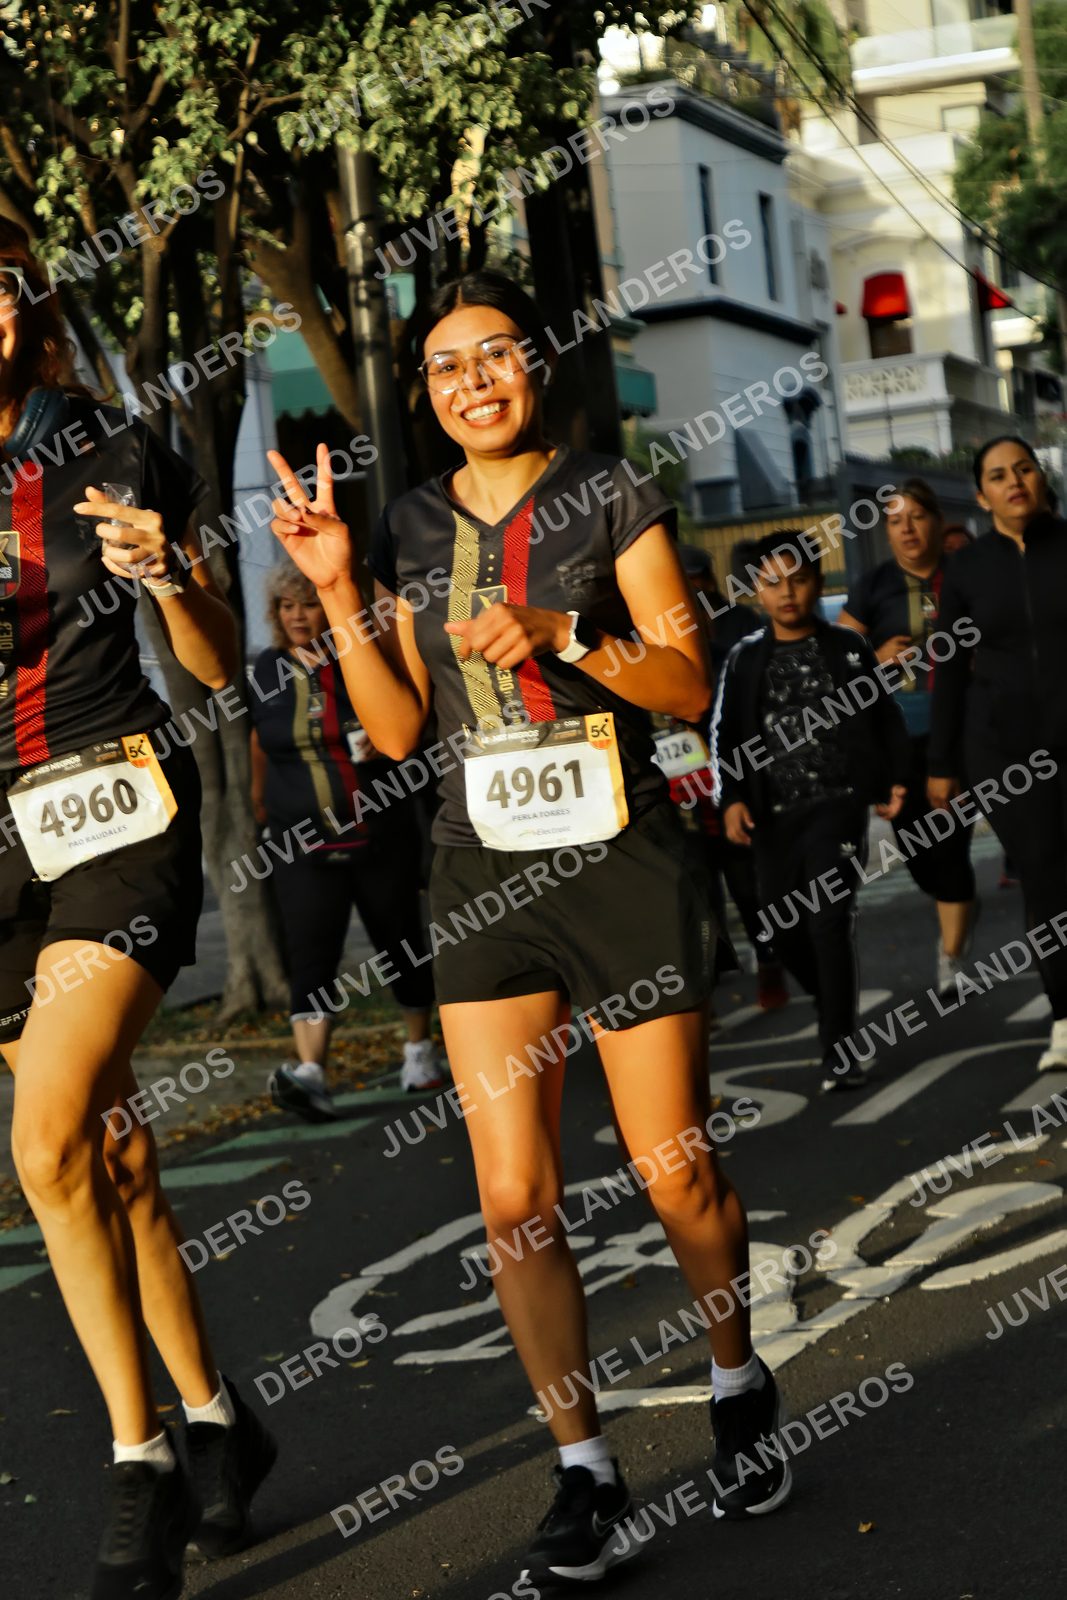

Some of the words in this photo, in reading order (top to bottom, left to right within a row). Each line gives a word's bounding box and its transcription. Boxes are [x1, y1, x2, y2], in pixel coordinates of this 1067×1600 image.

[591, 724, 609, 738] 5K
[129, 744, 147, 758] 5K
[486, 759, 585, 809] 4961
[40, 778, 138, 838] 4960
[512, 813, 538, 821] PERLA
